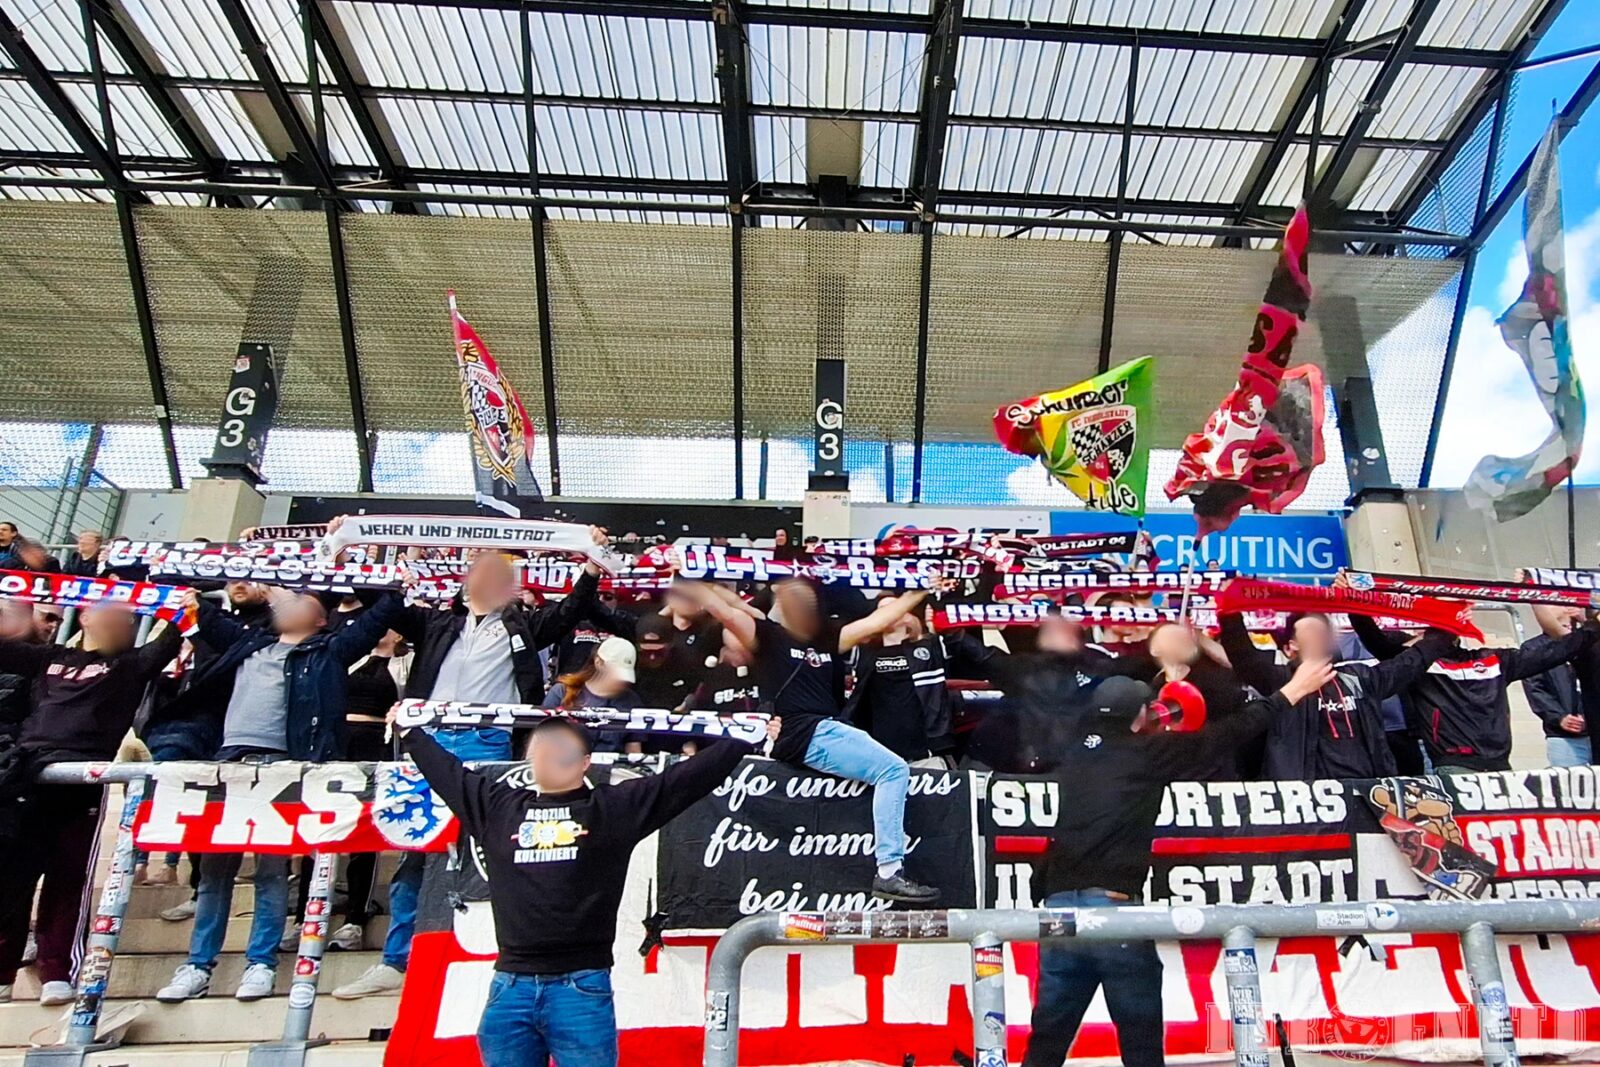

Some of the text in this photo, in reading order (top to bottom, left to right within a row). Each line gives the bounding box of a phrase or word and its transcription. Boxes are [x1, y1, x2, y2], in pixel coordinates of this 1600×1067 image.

[225, 387, 256, 416] G
[816, 401, 843, 430] G
[220, 419, 245, 447] 3
[818, 433, 840, 461] 3
[1082, 420, 1134, 466] SCHANZER
[359, 523, 556, 543] WEHEN UND INGOLSTADT
[1003, 571, 1227, 594] INGOLSTADT
[1449, 765, 1600, 811] SEKTIO
[135, 763, 369, 846] FKS
[525, 806, 572, 821] ASOZIAL
[990, 779, 1347, 828] SURTERS
[513, 846, 579, 864] KULTIVIERT
[704, 816, 921, 868] für immr
[1466, 818, 1600, 873] STADIO
[739, 878, 810, 915] bei
